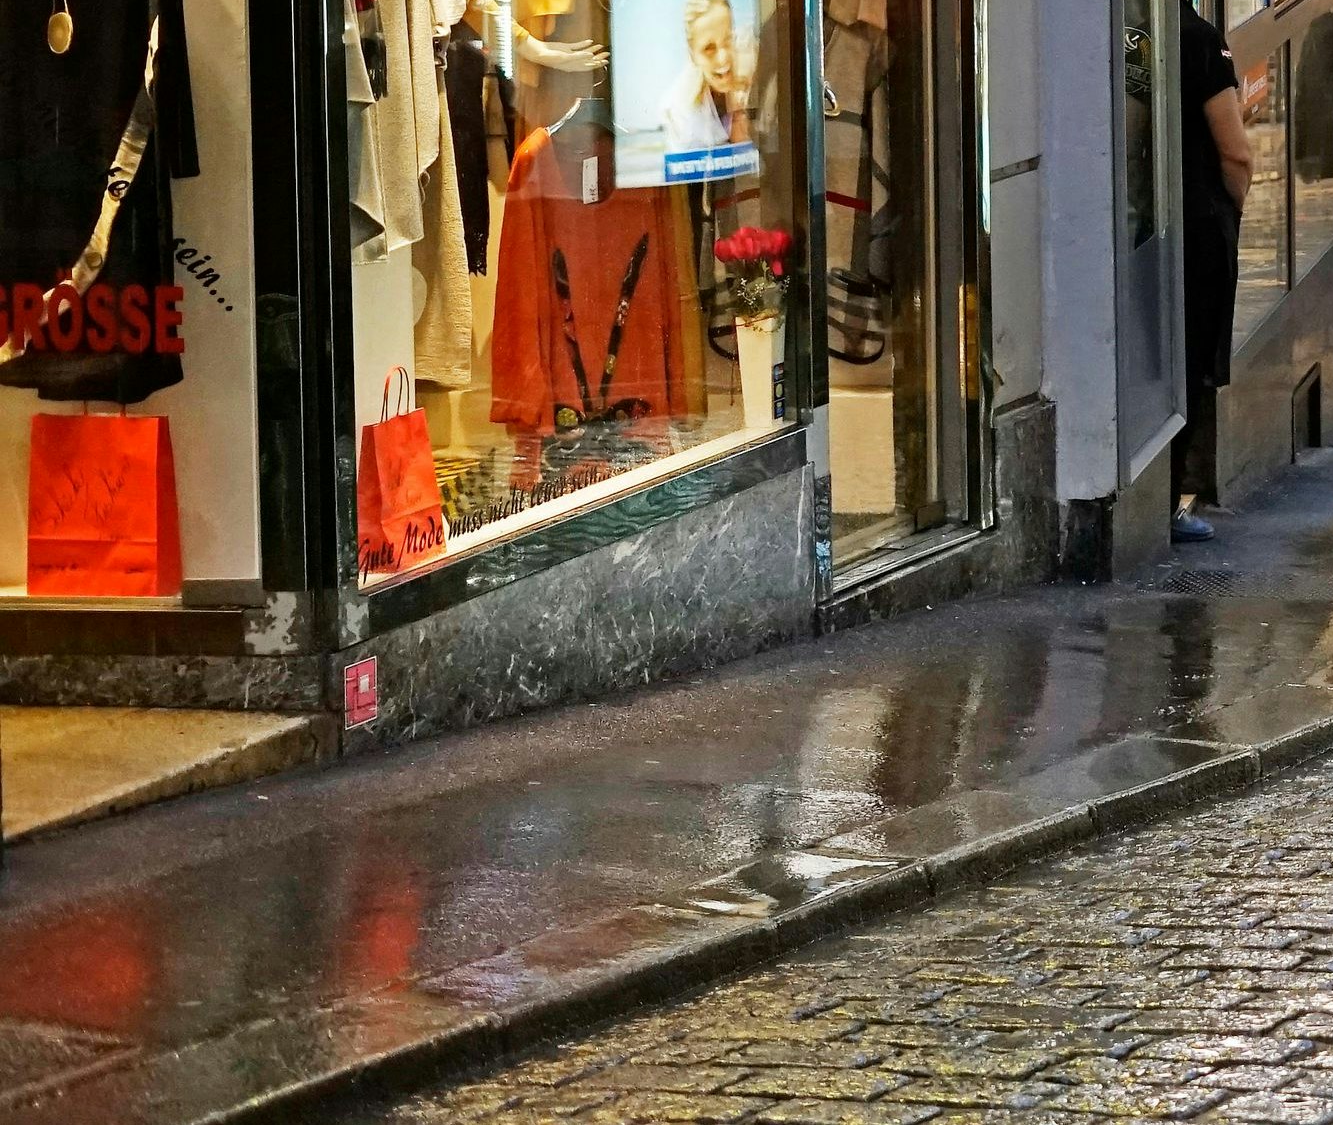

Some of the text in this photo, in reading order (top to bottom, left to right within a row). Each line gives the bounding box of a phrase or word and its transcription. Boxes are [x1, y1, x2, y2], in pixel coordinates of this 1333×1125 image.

[397, 515, 444, 568] Mode
[448, 511, 484, 540] muss
[487, 487, 526, 525] nicht
